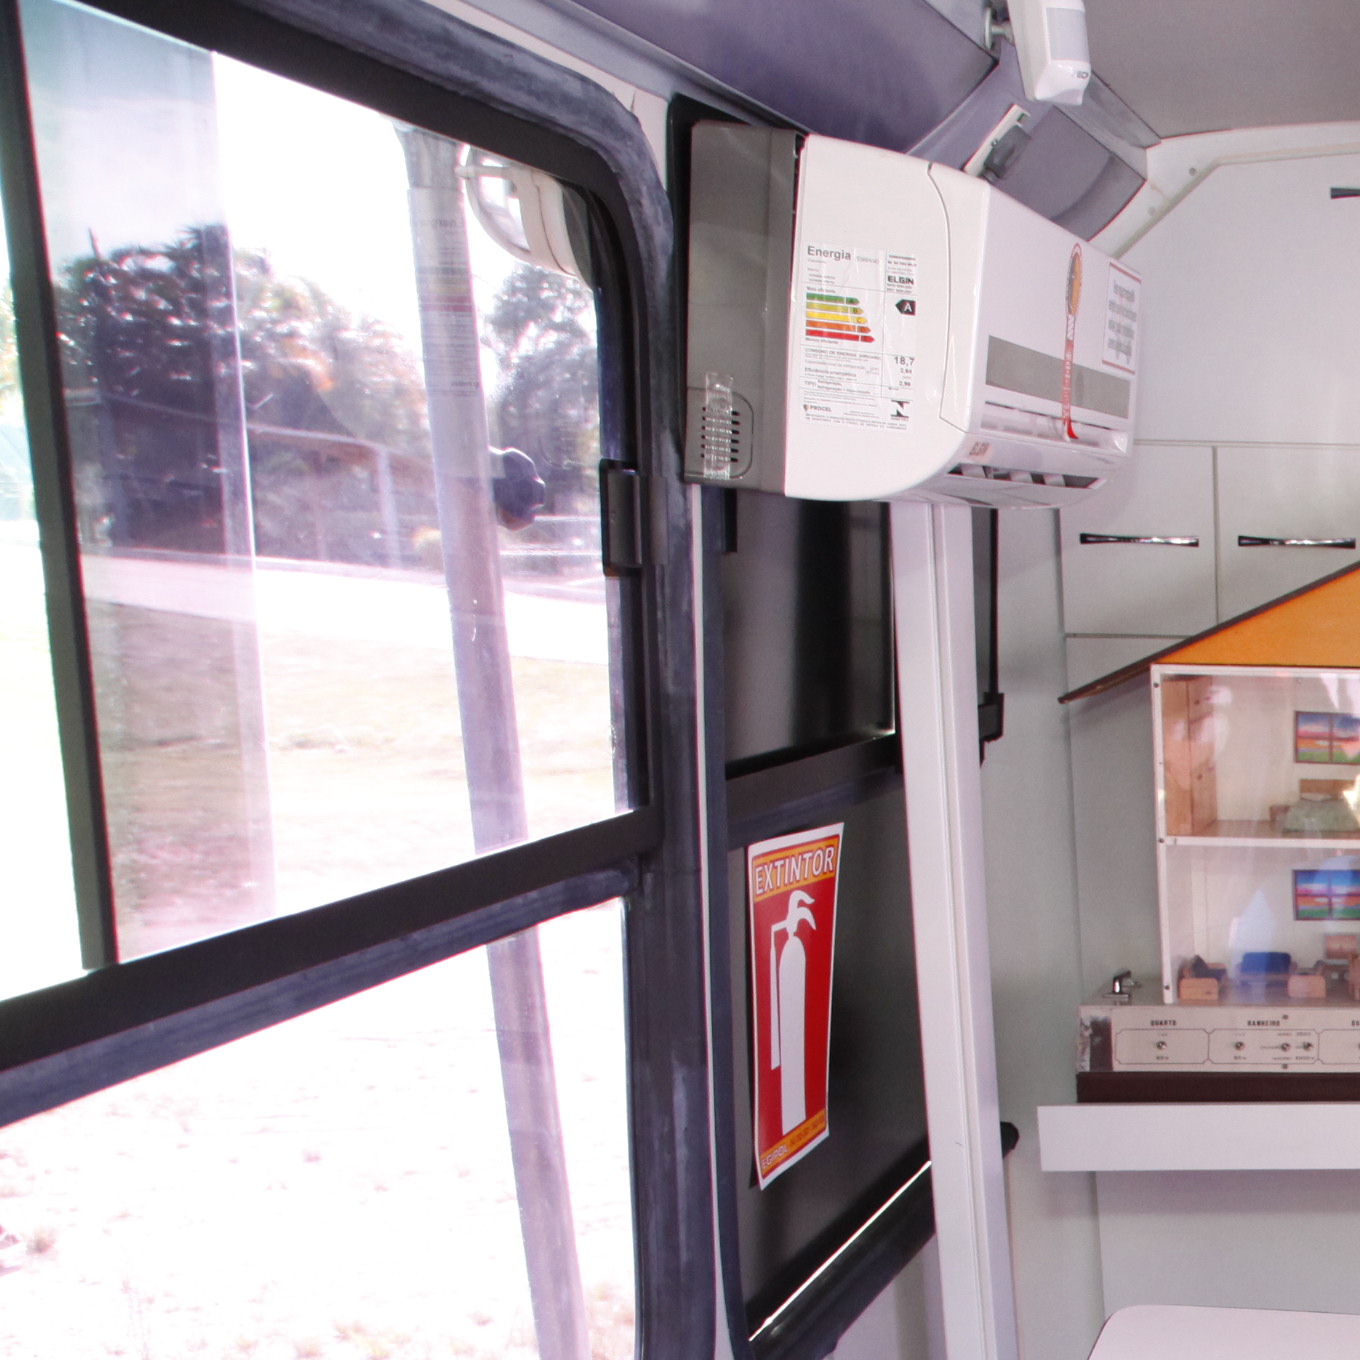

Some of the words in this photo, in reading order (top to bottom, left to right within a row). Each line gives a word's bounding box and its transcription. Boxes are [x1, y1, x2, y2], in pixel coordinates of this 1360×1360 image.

[807, 245, 851, 261] Energia
[887, 275, 915, 285] ELGIN
[903, 302, 912, 312] A
[894, 356, 915, 367] 18,7
[755, 846, 834, 895] EXTINTOR
